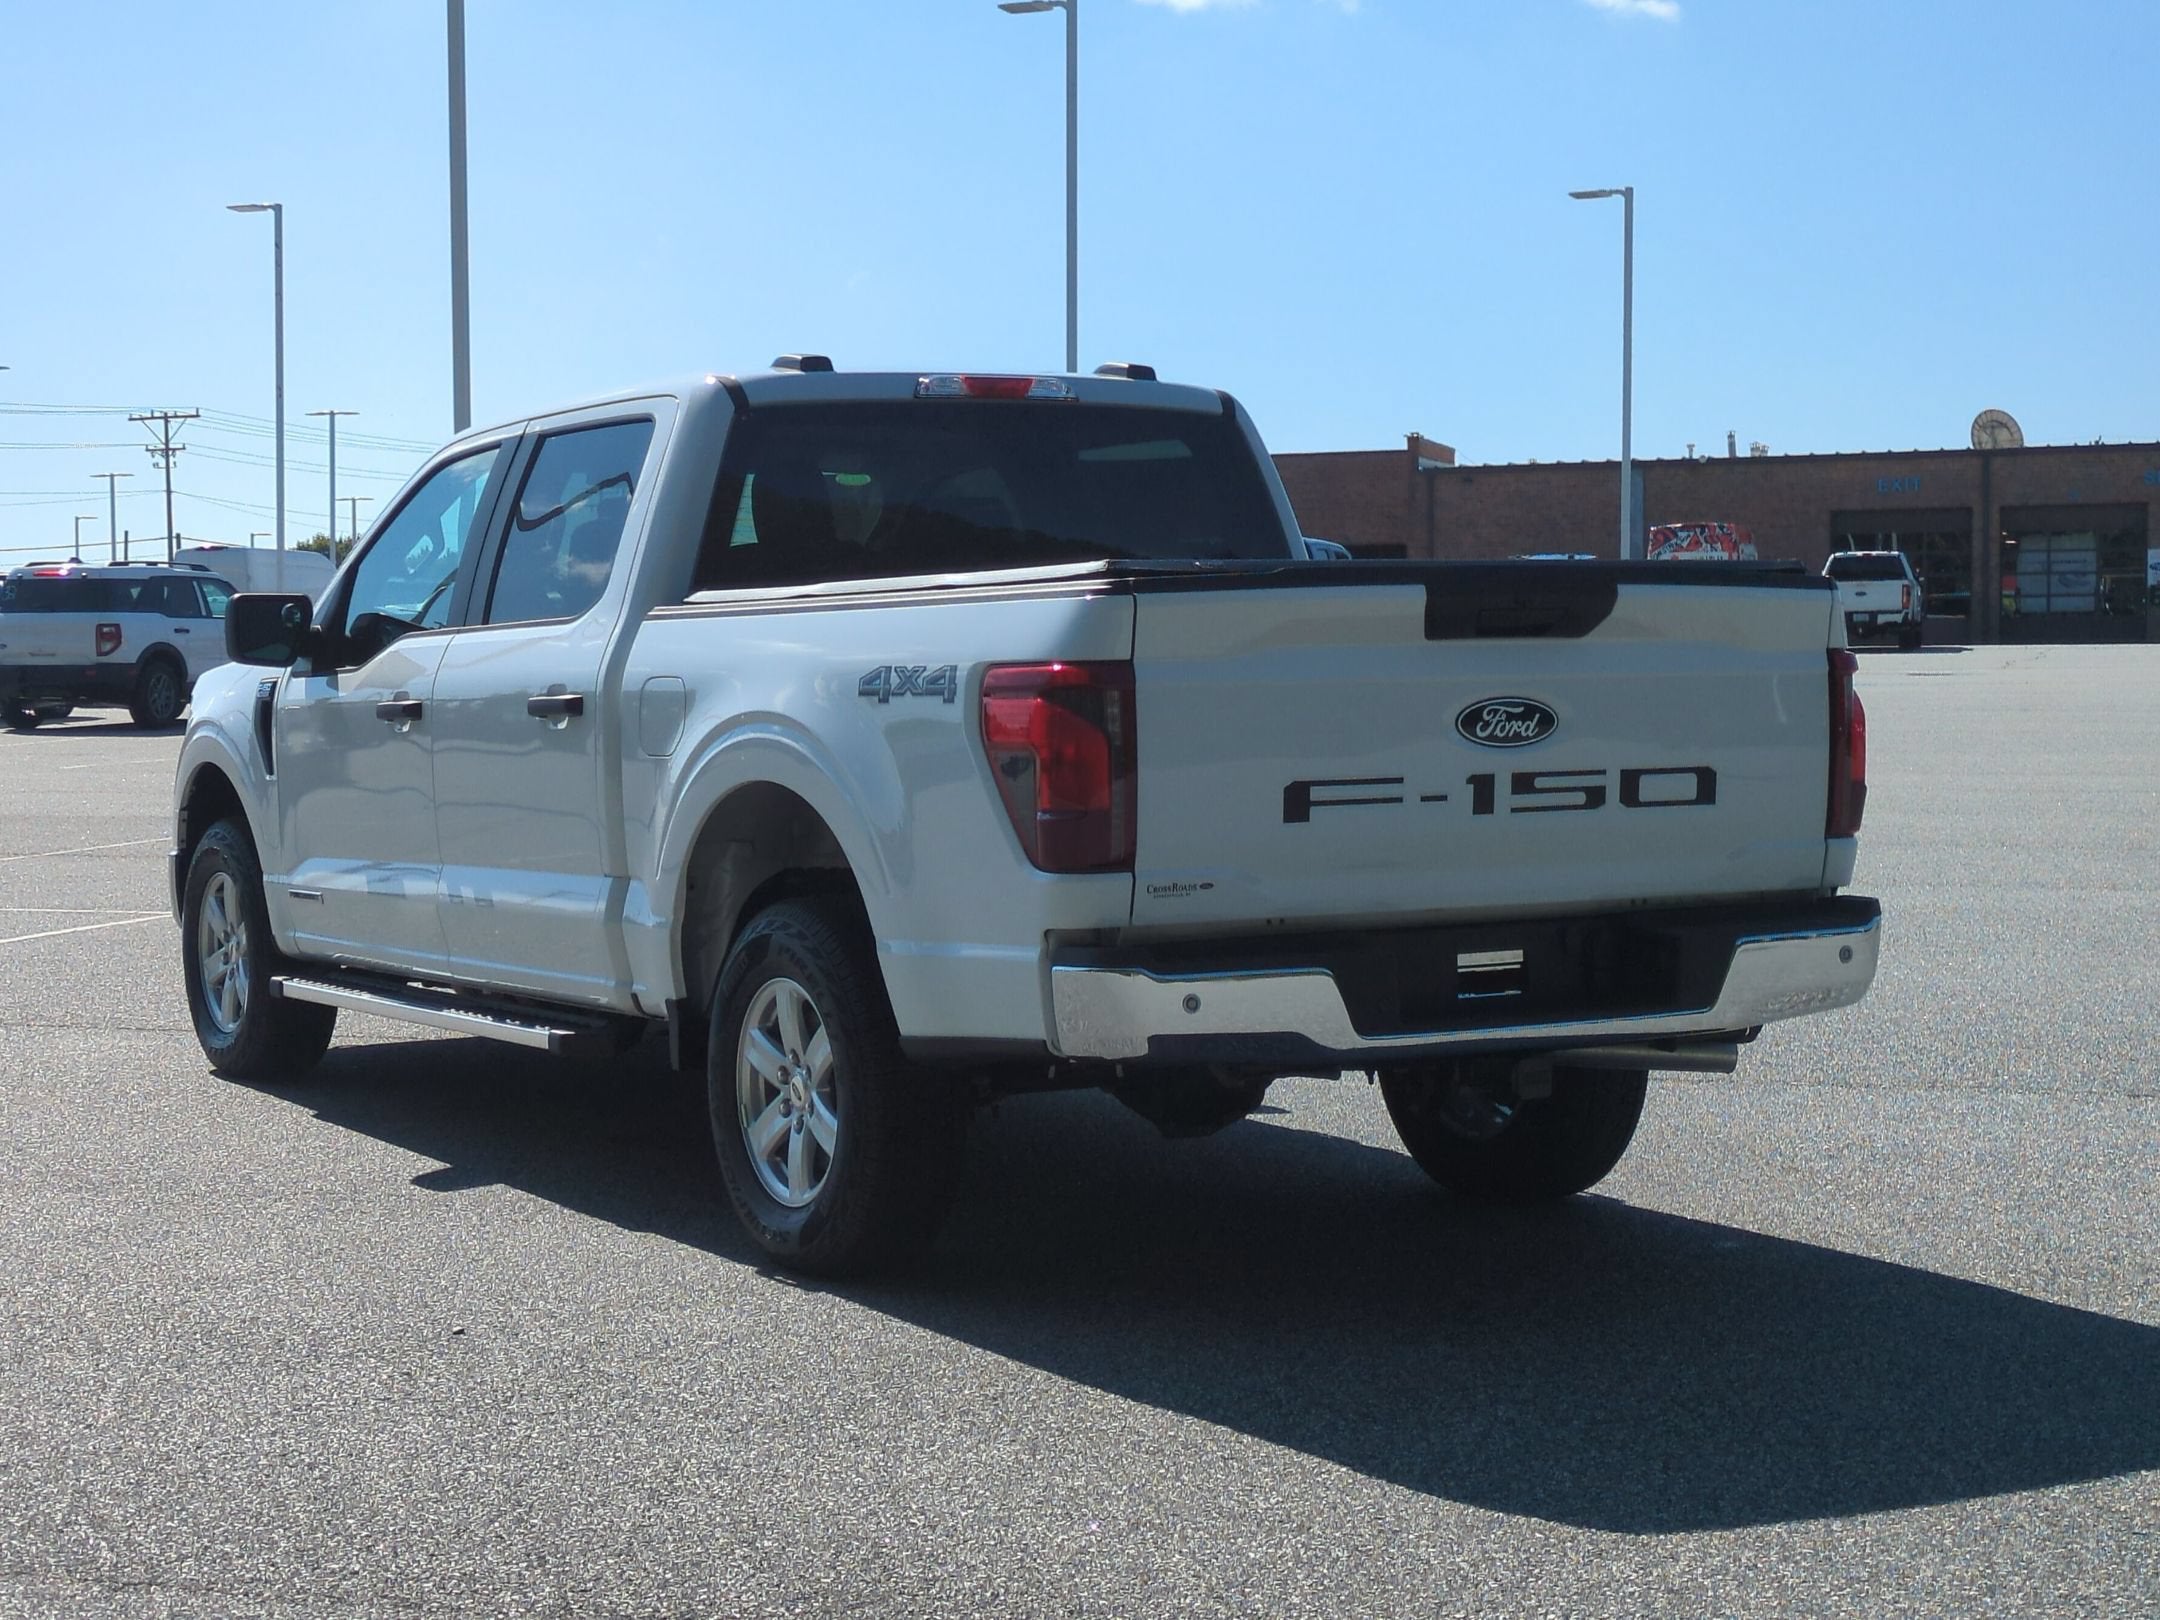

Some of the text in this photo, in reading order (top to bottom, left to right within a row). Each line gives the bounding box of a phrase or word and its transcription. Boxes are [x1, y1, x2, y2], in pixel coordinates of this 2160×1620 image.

[1877, 475, 1920, 493] EXIT
[1476, 705, 1541, 738] Ford
[1282, 766, 1717, 823] F-150
